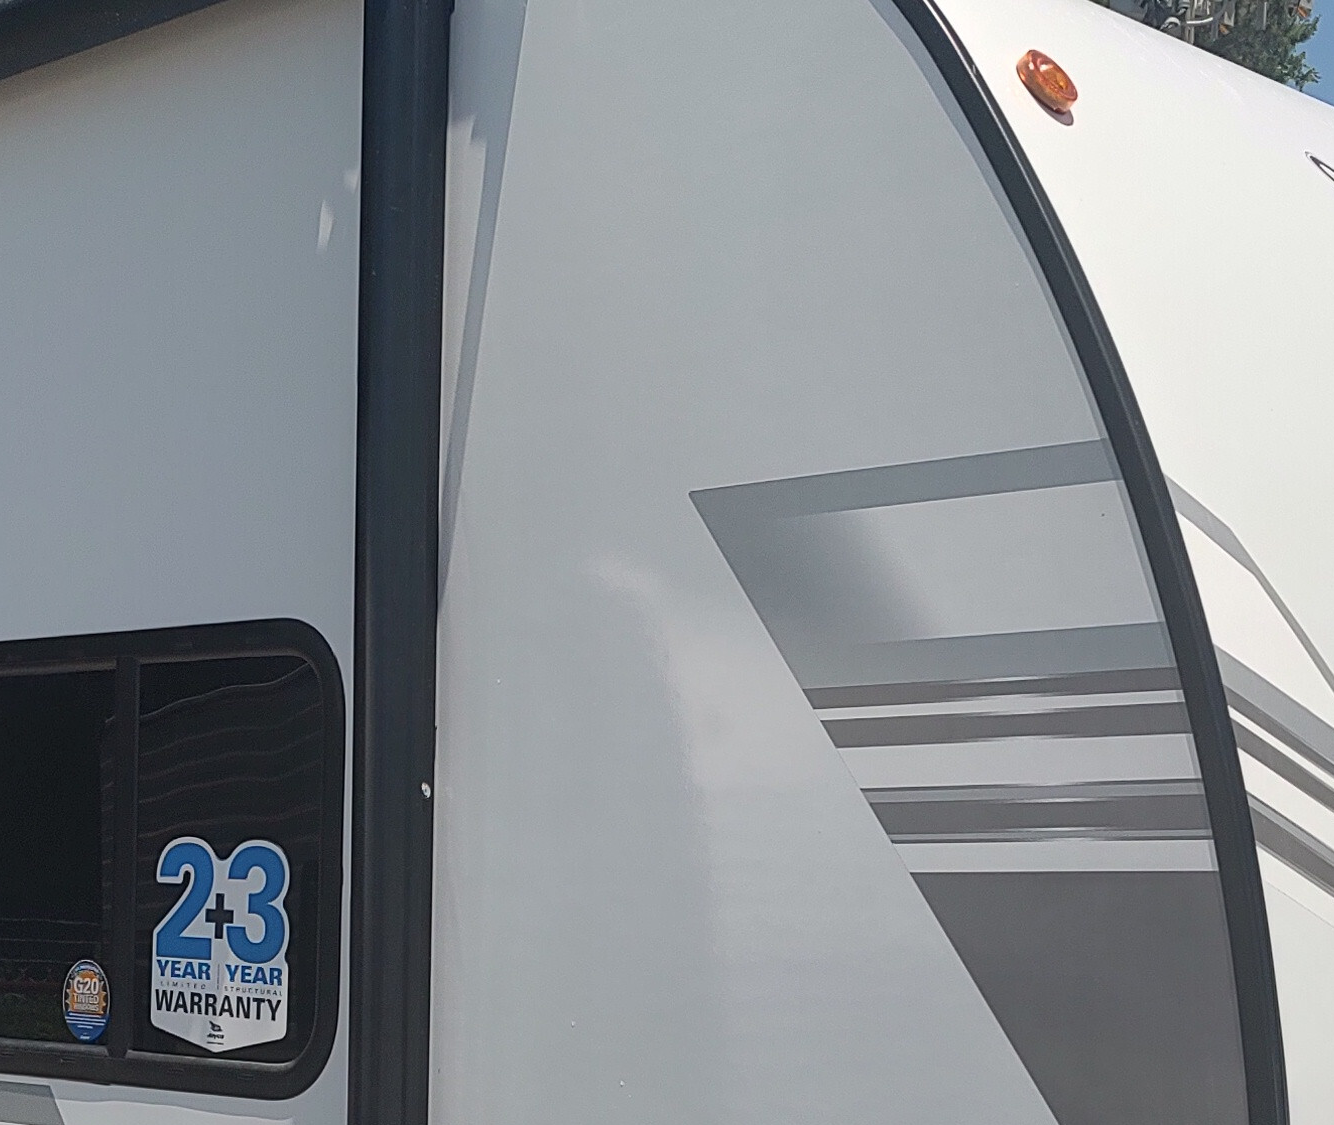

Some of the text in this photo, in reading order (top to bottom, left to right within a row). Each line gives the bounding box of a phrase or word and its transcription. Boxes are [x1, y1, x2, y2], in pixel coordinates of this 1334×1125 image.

[156, 959, 283, 987] YEAR YEAR
[73, 976, 99, 995] G20
[160, 981, 283, 997] LIMITED STRUCTURAL
[73, 993, 99, 1004] TINTED
[155, 989, 282, 1022] WARRANTY
